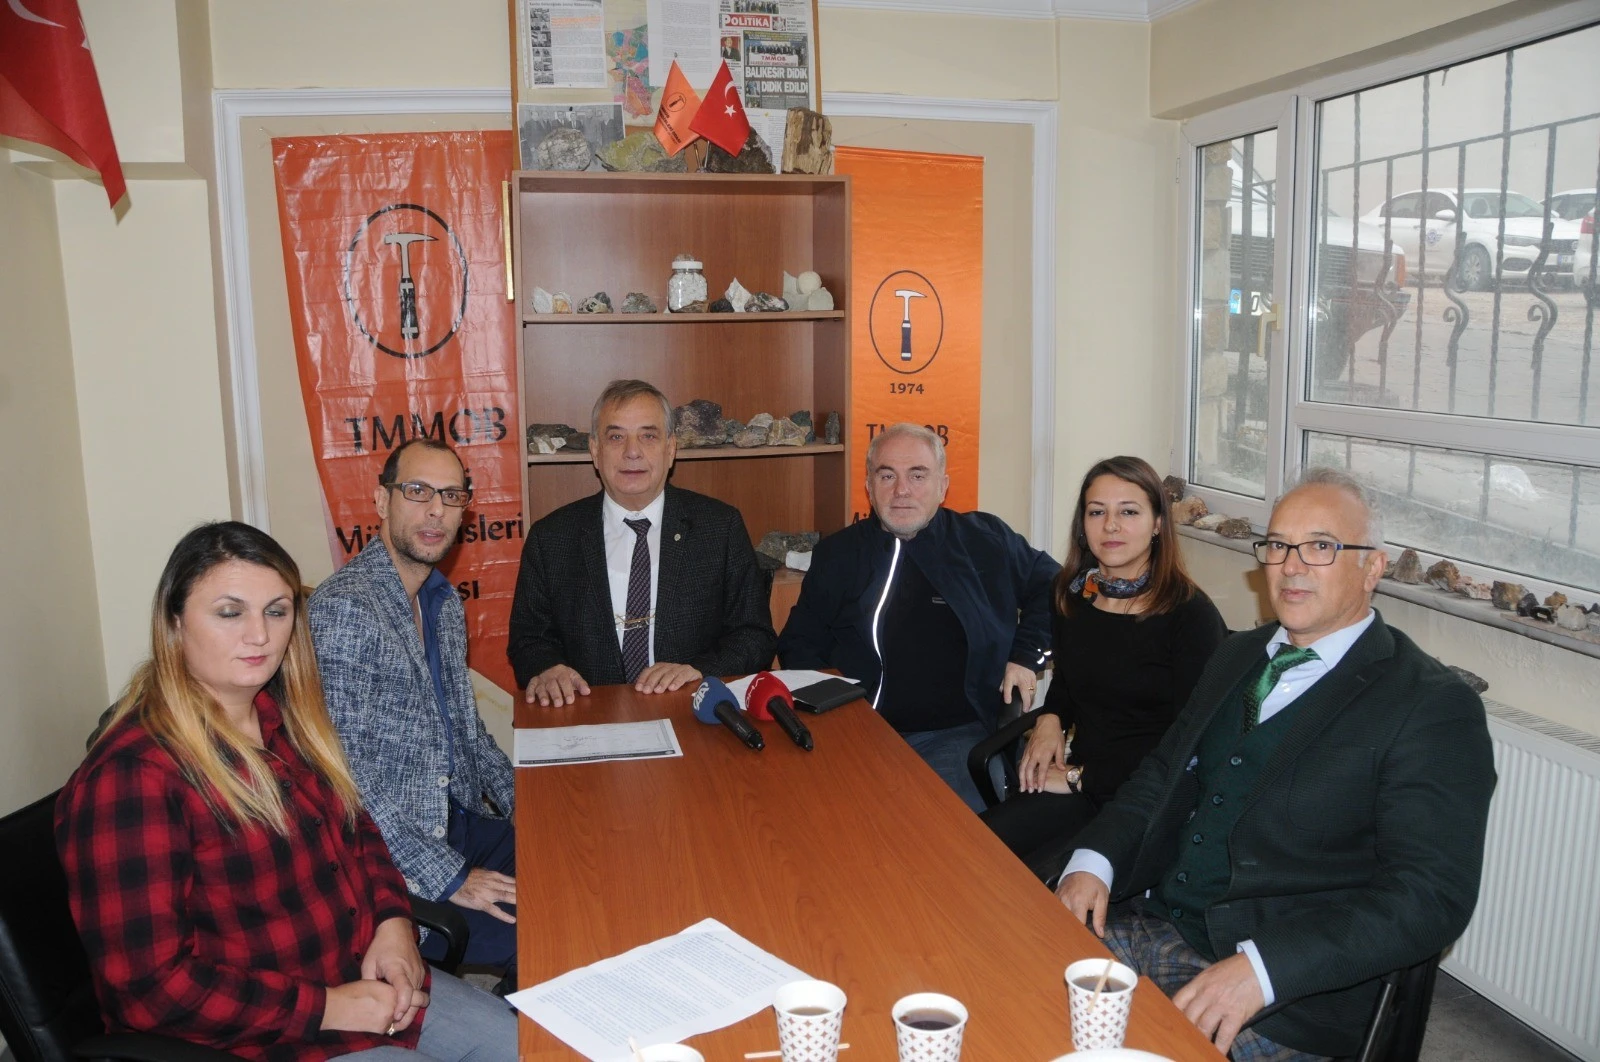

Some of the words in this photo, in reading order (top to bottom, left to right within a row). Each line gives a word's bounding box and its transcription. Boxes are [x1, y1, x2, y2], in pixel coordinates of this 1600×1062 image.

[745, 67, 785, 78] BALIKESİR
[786, 67, 808, 79] DİDİK
[761, 81, 782, 92] DİDİK
[784, 82, 808, 93] EDİLDİ
[889, 382, 925, 395] 1974
